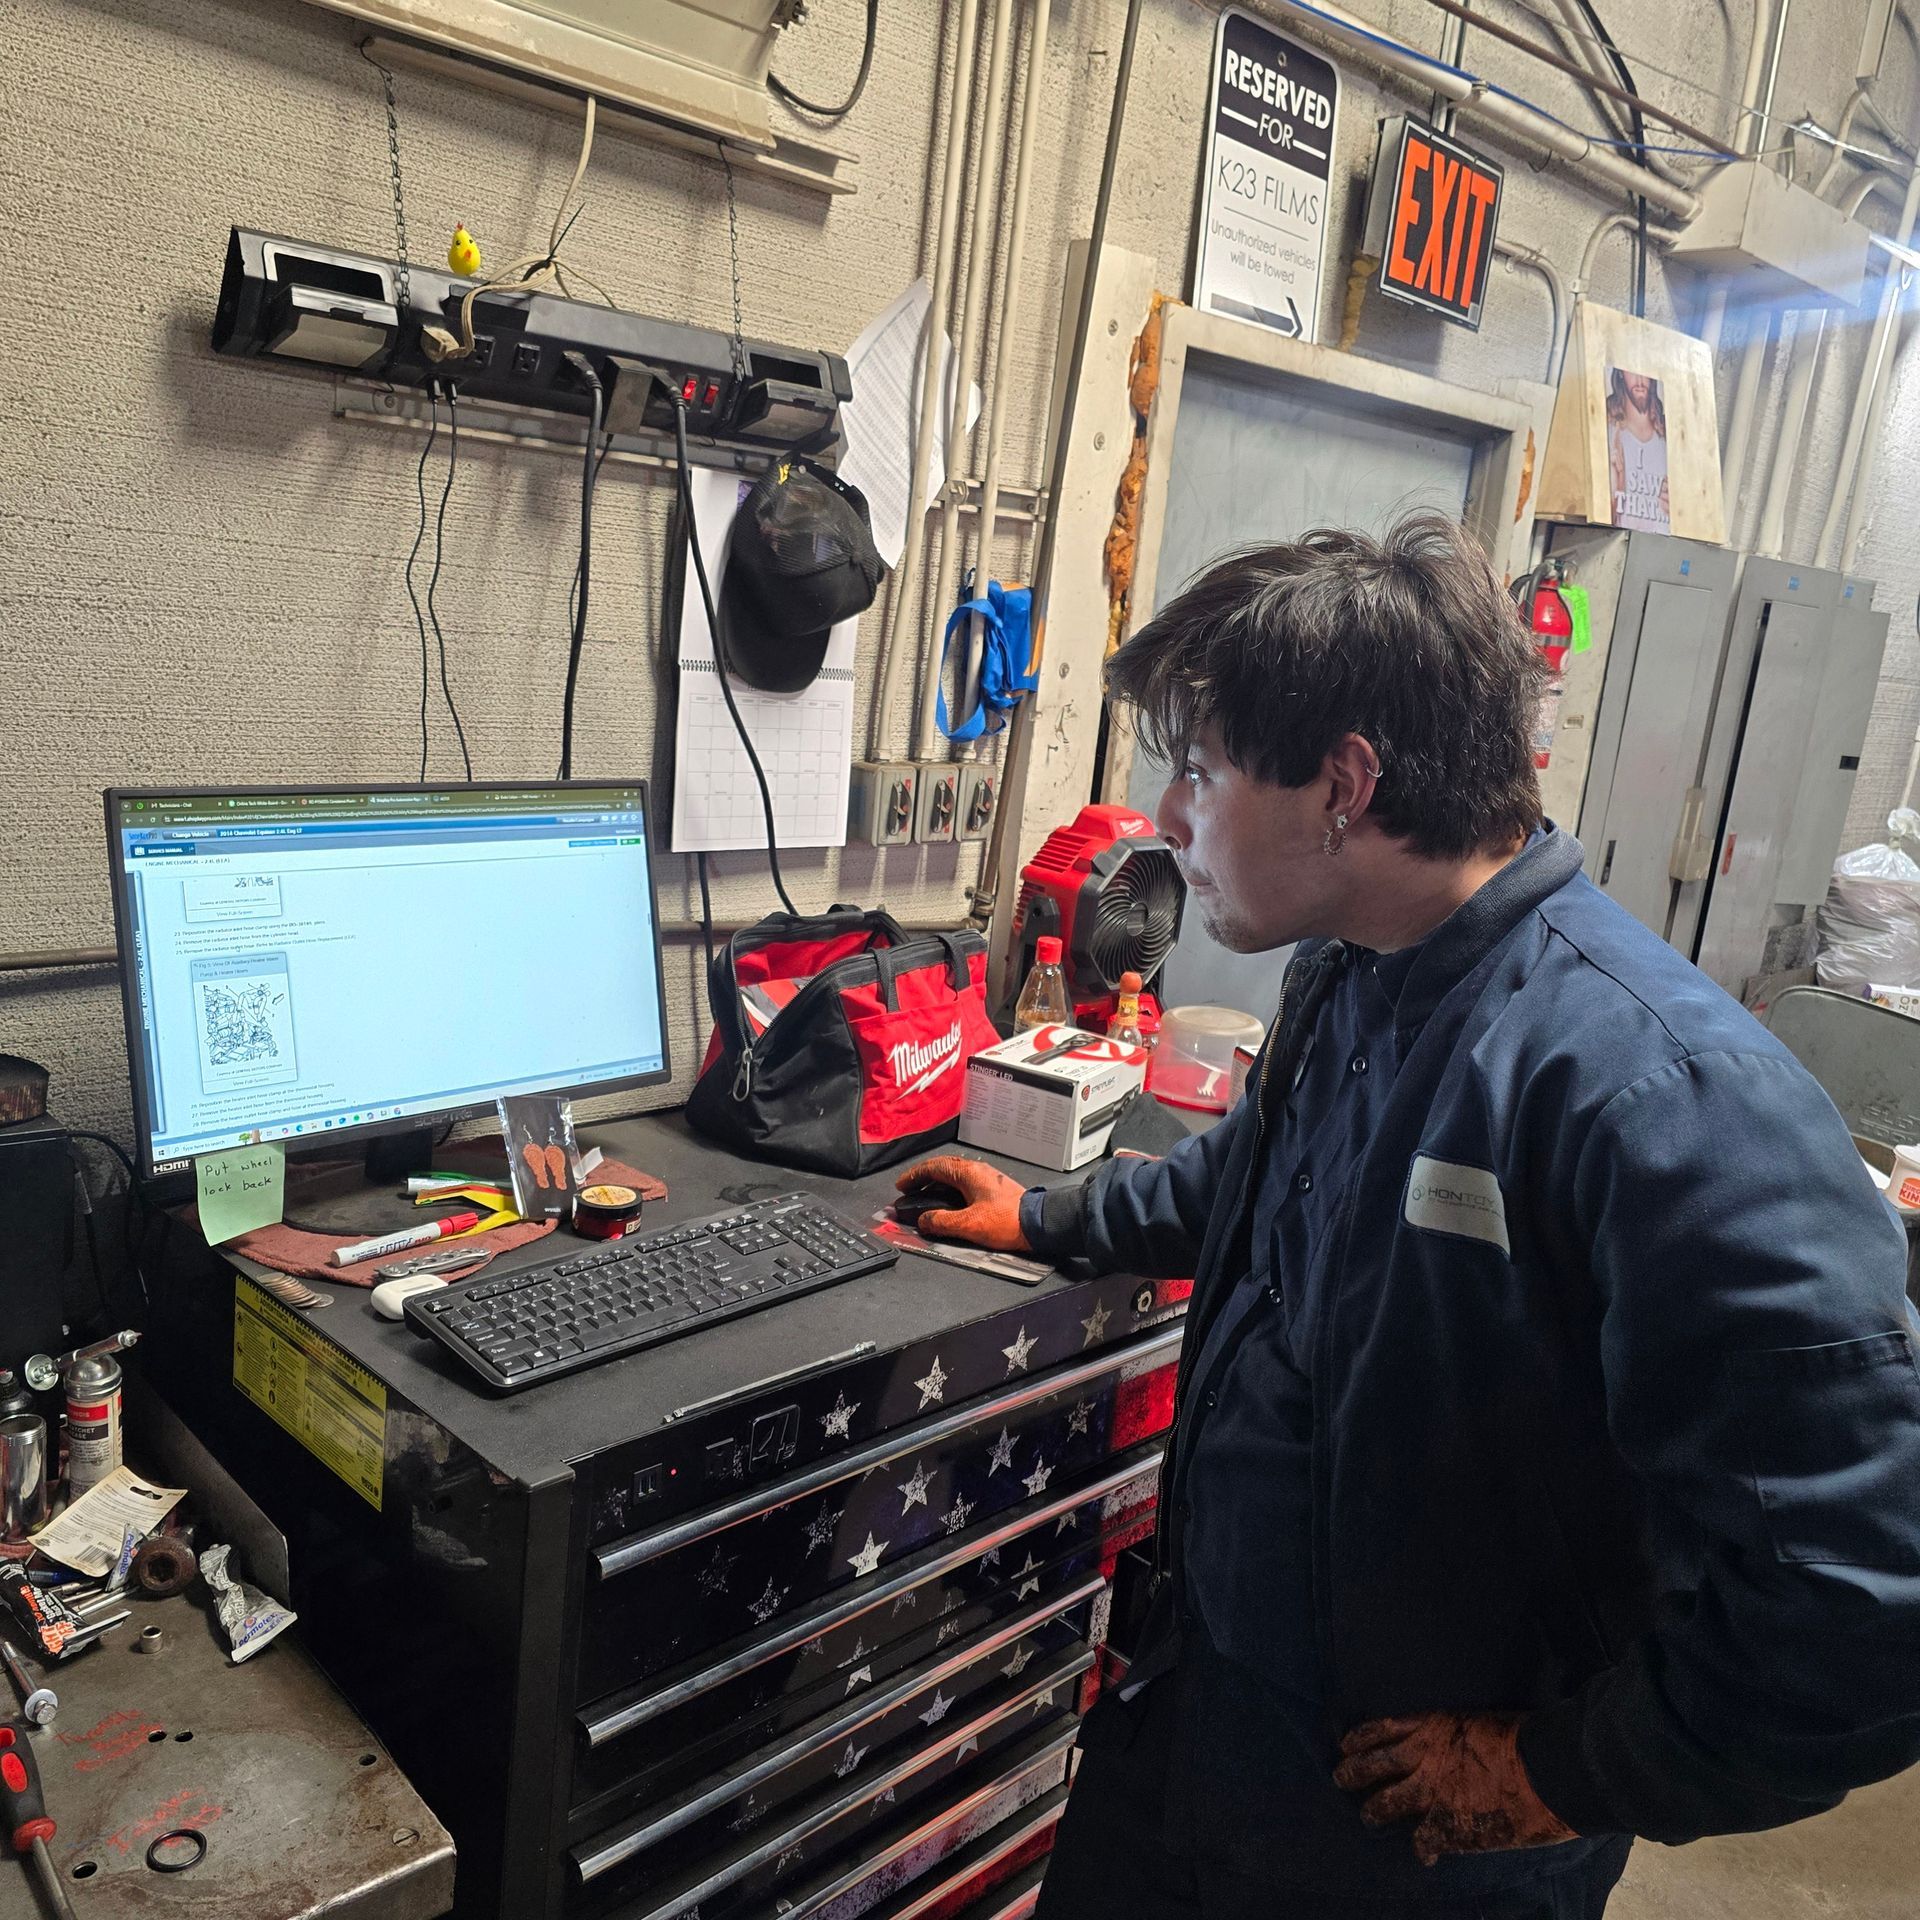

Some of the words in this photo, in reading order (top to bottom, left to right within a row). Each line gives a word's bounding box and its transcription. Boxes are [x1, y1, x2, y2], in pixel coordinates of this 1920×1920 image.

[1224, 48, 1331, 129] RESERVED
[1259, 113, 1293, 149] FOR
[1218, 155, 1256, 199] K23
[1264, 176, 1319, 225] FILMS
[1389, 137, 1496, 308] EXIT
[1211, 219, 1276, 256] Unauthorized
[1279, 248, 1316, 271] vehicles
[1230, 250, 1246, 266] will
[1248, 256, 1260, 272] be
[1263, 262, 1294, 284] towed
[1637, 448, 1644, 470] I
[1629, 473, 1664, 497] SAW
[969, 1063, 999, 1079] STINGER
[999, 1072, 1014, 1082] LED
[153, 1160, 189, 1174] HDMI
[205, 1162, 229, 1176] Put
[240, 1156, 272, 1171] wheel
[205, 1182, 232, 1196] lock
[242, 1176, 272, 1191] back
